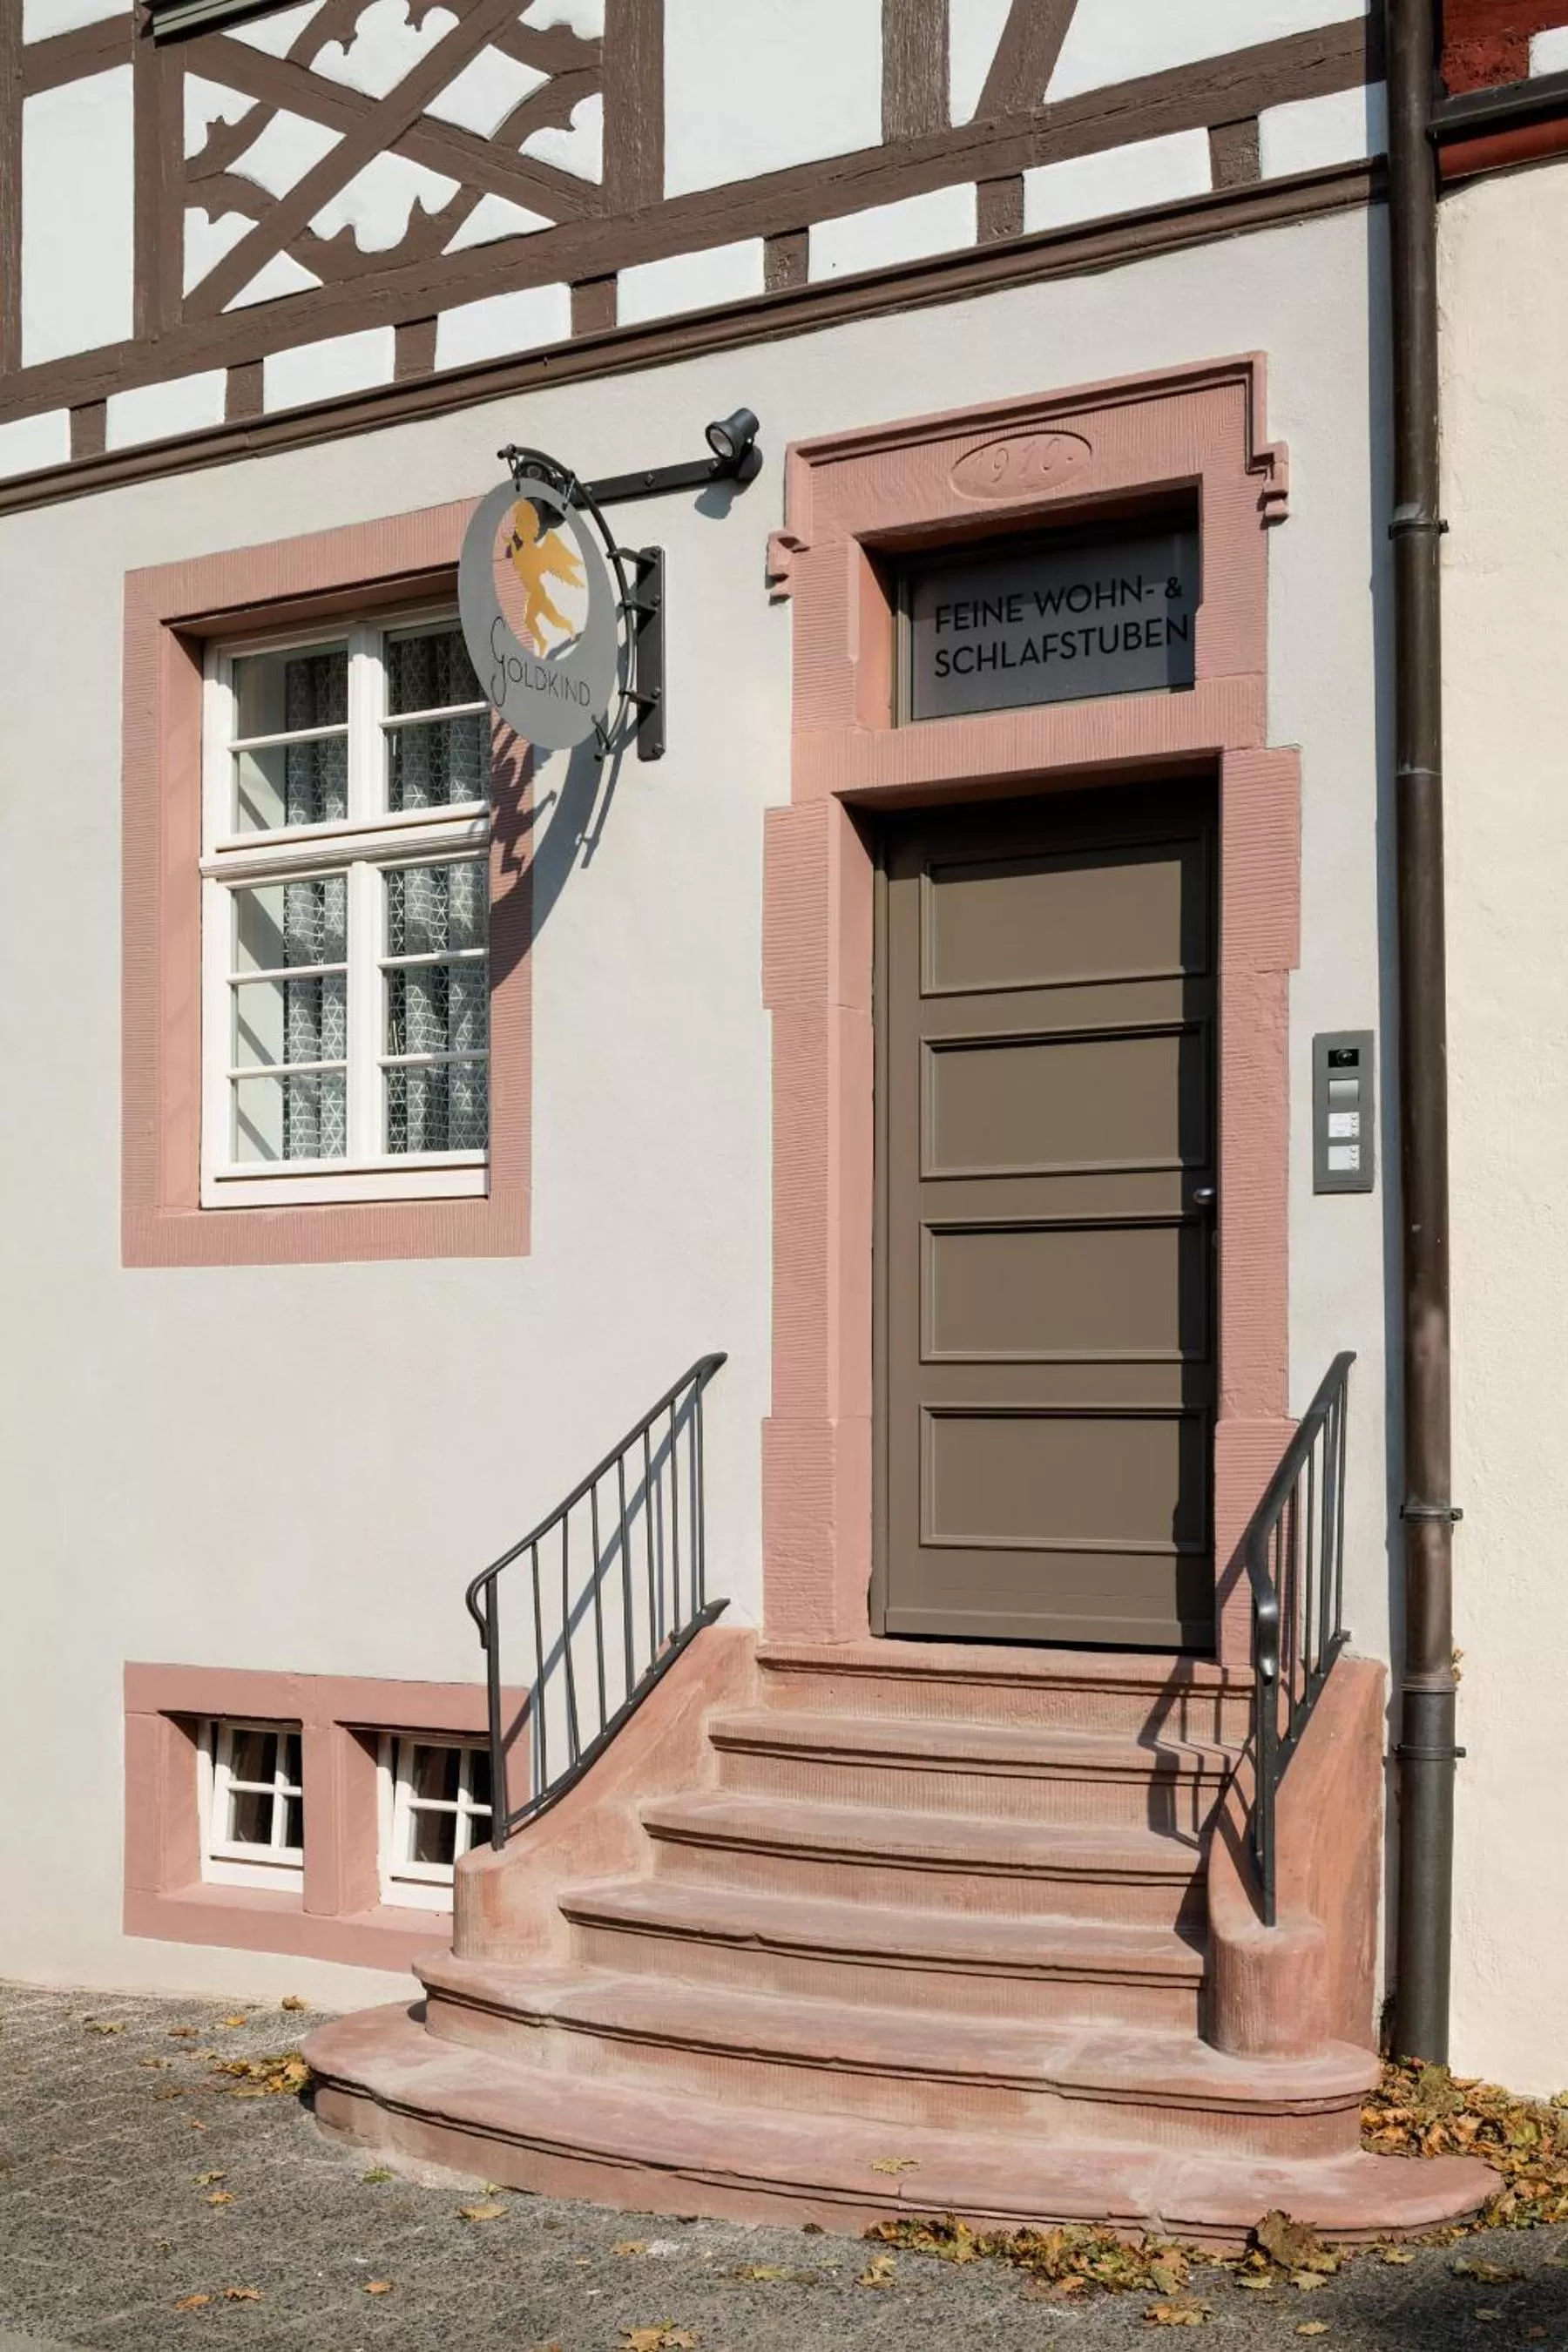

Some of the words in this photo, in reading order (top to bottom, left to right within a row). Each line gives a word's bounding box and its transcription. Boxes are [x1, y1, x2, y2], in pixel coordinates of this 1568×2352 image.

[935, 593, 1024, 634] FEINE
[1034, 574, 1154, 618] WOHN-
[1164, 576, 1183, 599] &
[490, 615, 591, 707] GOLDKIND
[934, 613, 1188, 678] SCHLAFSTUBEN
